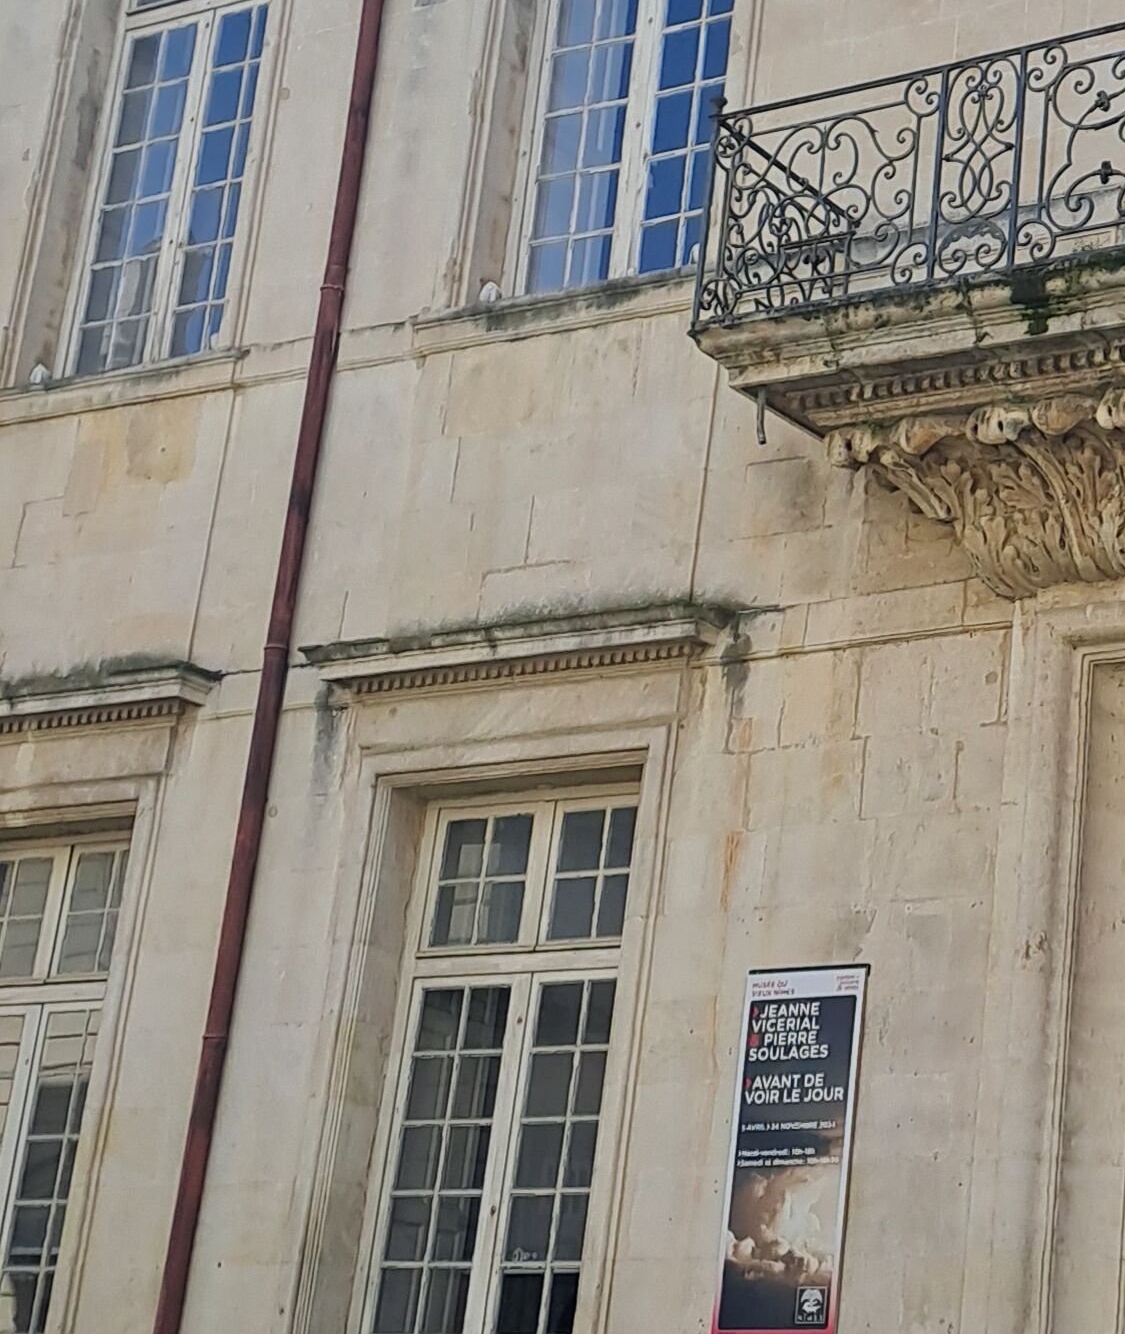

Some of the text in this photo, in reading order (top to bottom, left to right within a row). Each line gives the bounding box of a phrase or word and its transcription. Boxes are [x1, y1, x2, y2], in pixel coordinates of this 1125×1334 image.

[759, 1002, 820, 1018] JEANNE
[752, 1017, 820, 1033] VICERIAL
[764, 1031, 817, 1046] PIERRE
[748, 1044, 829, 1062] SOULAGES
[752, 1072, 825, 1090] AVANT DE
[745, 1087, 844, 1105] VOIR LE JOUR
